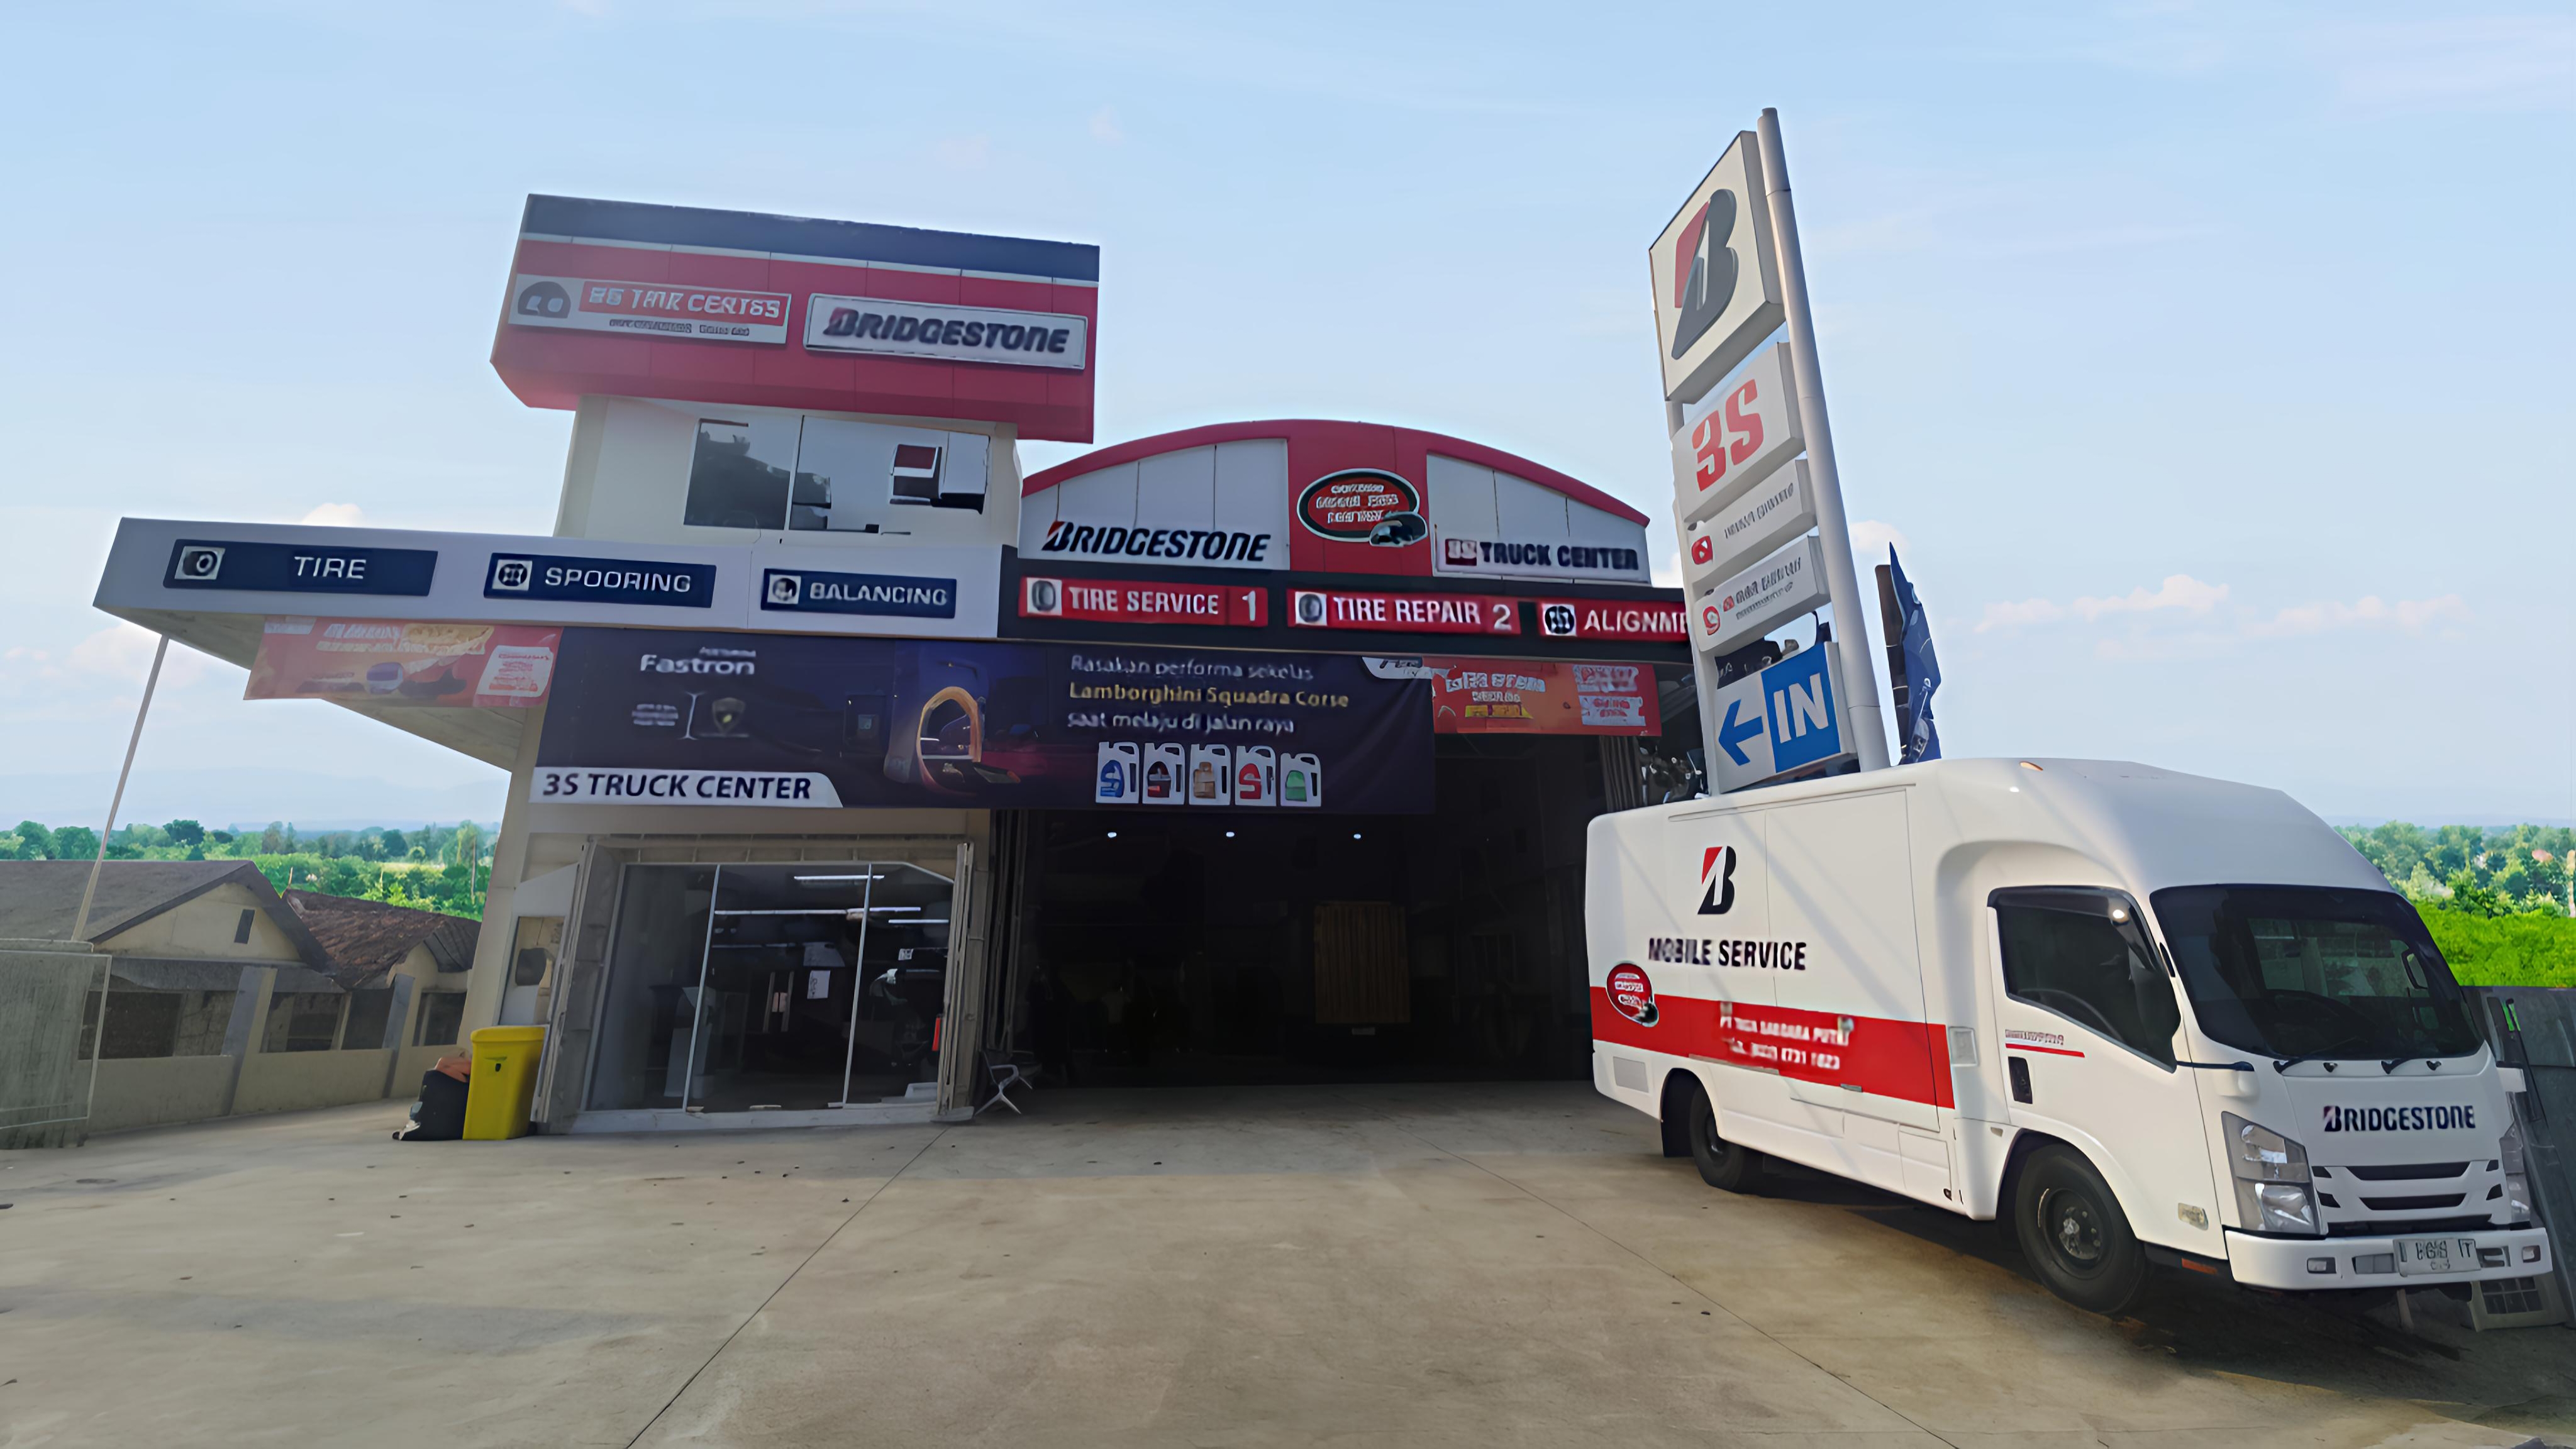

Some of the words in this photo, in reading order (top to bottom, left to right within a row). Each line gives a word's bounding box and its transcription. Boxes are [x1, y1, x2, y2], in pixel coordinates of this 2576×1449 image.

[823, 307, 1070, 353] BRIDGESTONE
[1692, 377, 1764, 492] 3S
[1041, 521, 1271, 562] BRIDGESTONE
[1479, 541, 1552, 566] TRUCK
[294, 556, 367, 579] TIRE
[545, 567, 692, 593] SPOORING
[809, 582, 948, 606] BALANCING
[1069, 586, 1119, 612] TIRE
[1127, 590, 1219, 615] SERVICE
[1241, 590, 1256, 622] 1
[1333, 596, 1387, 621] TIRE
[1395, 599, 1481, 625] REPAIR
[1492, 604, 1512, 630] 2
[640, 654, 755, 675] Fastron
[1071, 655, 1150, 674] Rasakan
[1155, 658, 1243, 679] performa
[1070, 682, 1202, 706] Lamborghini
[1206, 686, 1291, 708] Squadra
[1295, 691, 1350, 708] Corse
[1772, 672, 1829, 744] IN
[543, 773, 579, 796] 3S
[588, 773, 690, 797] TRUCK
[696, 775, 811, 799] CENTER
[1648, 937, 1712, 966] MOBILE
[1718, 940, 1807, 971] SERVICE
[2323, 1105, 2476, 1132] BRIDGESTONE
